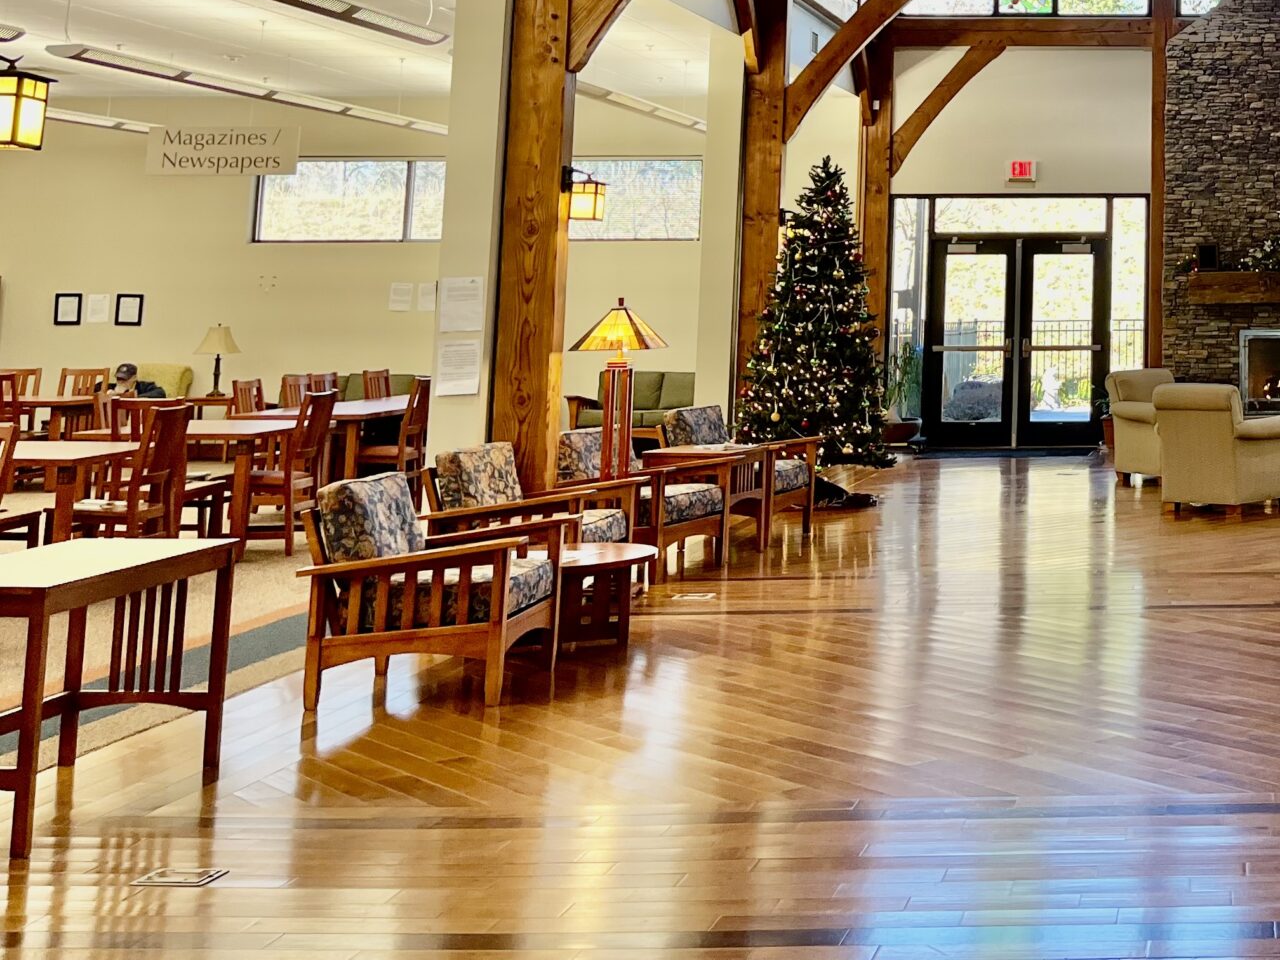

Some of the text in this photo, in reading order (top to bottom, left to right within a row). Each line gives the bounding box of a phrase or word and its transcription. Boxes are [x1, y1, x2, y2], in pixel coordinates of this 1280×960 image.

[162, 129, 282, 151] Magazines /
[161, 152, 281, 174] Newspapers
[1012, 160, 1032, 177] EXIT
